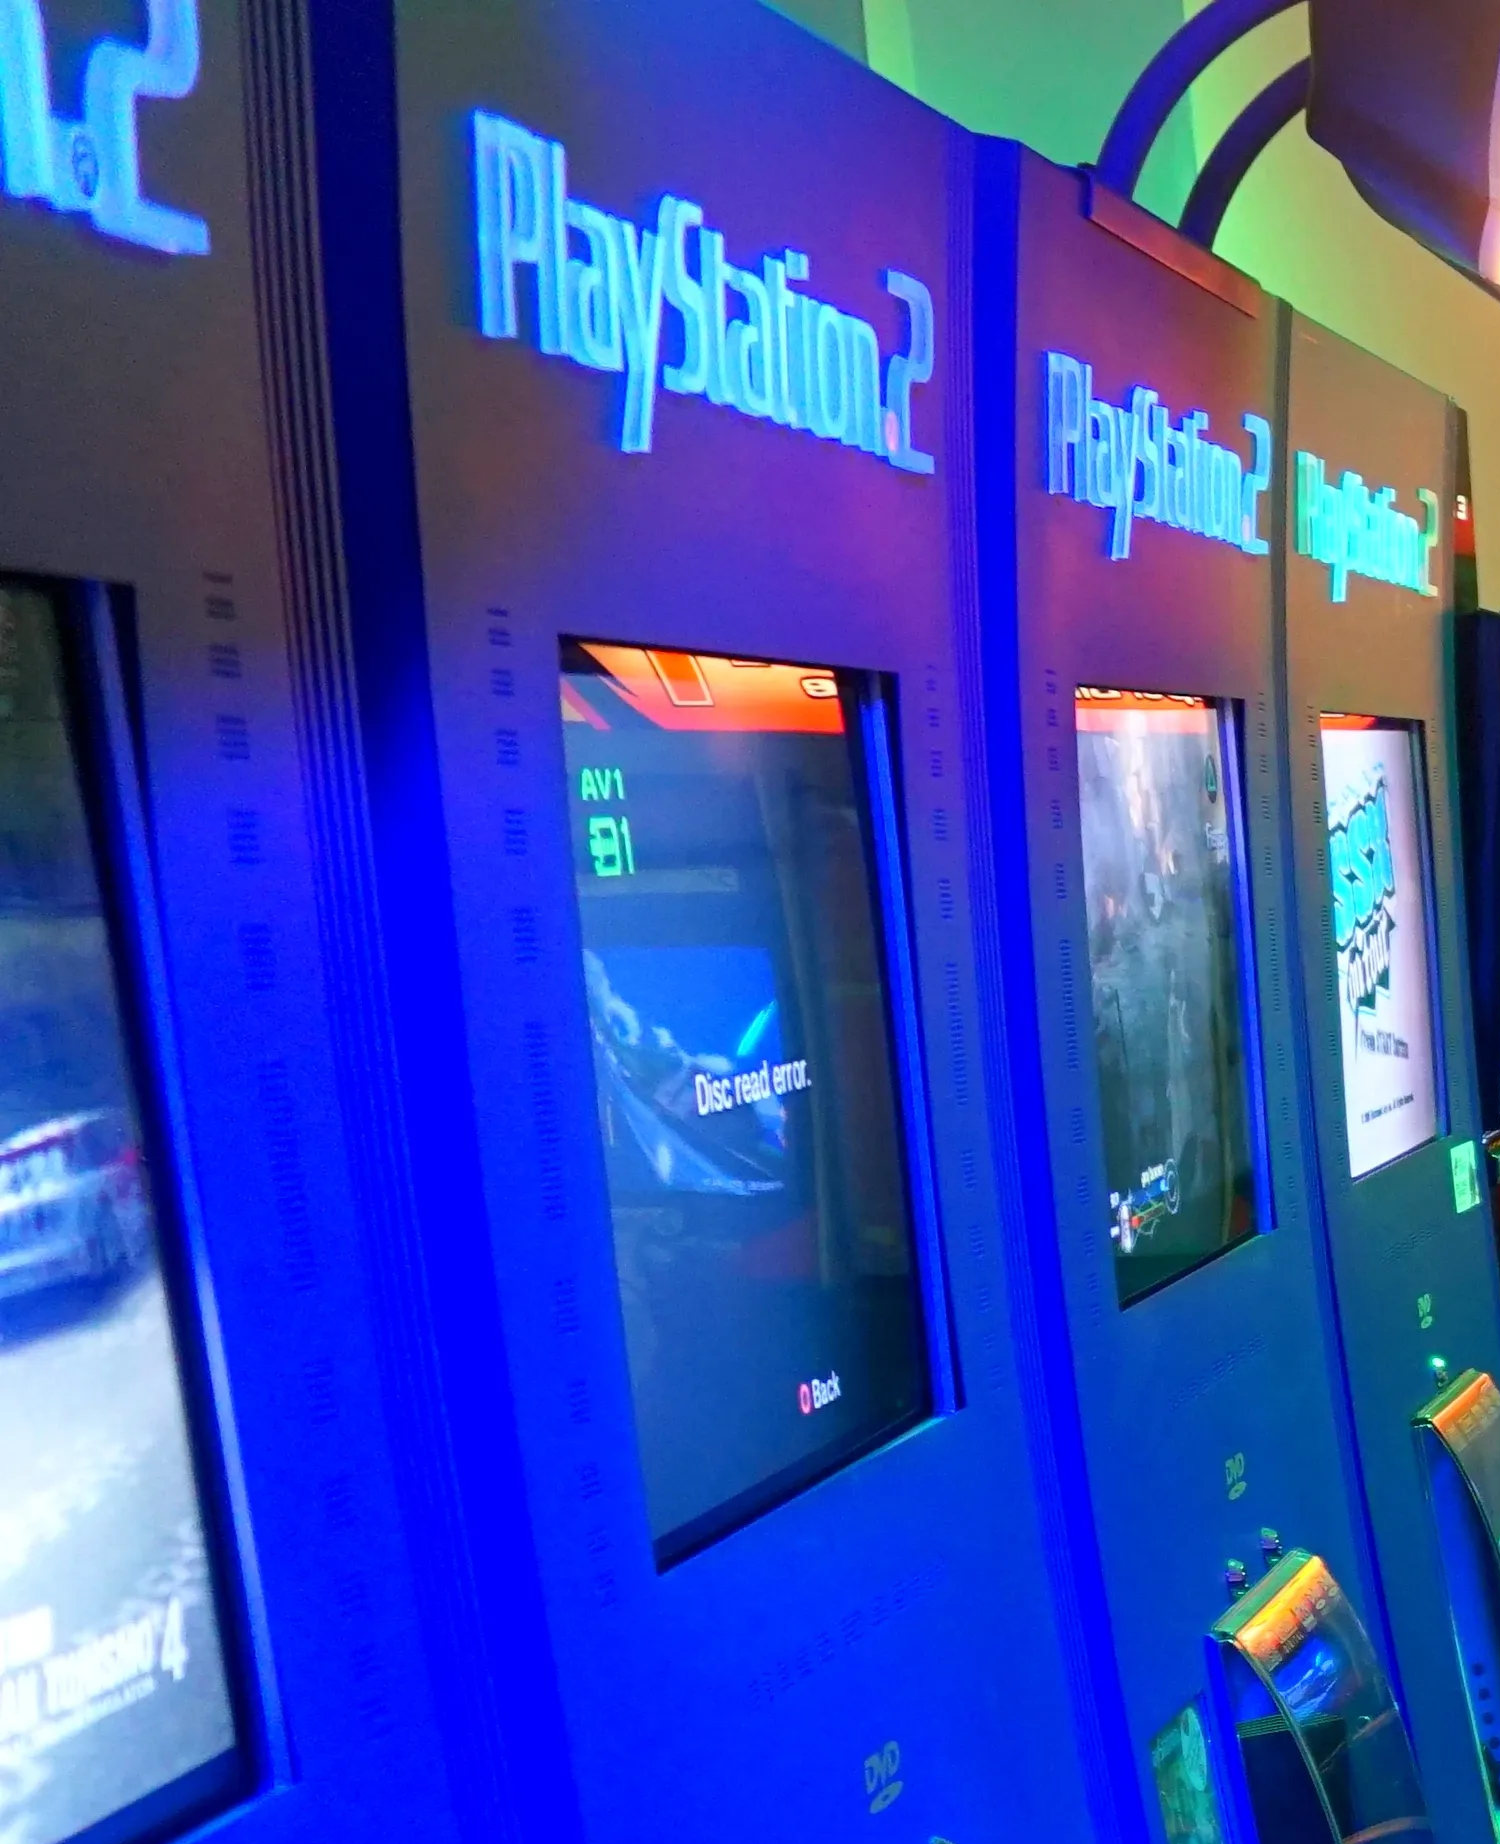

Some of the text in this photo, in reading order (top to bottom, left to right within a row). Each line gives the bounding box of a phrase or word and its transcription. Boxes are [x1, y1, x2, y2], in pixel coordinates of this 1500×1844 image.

[580, 765, 626, 802] AV1
[695, 1055, 812, 1117] Disc read error.
[811, 1370, 842, 1409] Back
[864, 1740, 901, 1797] DVD
